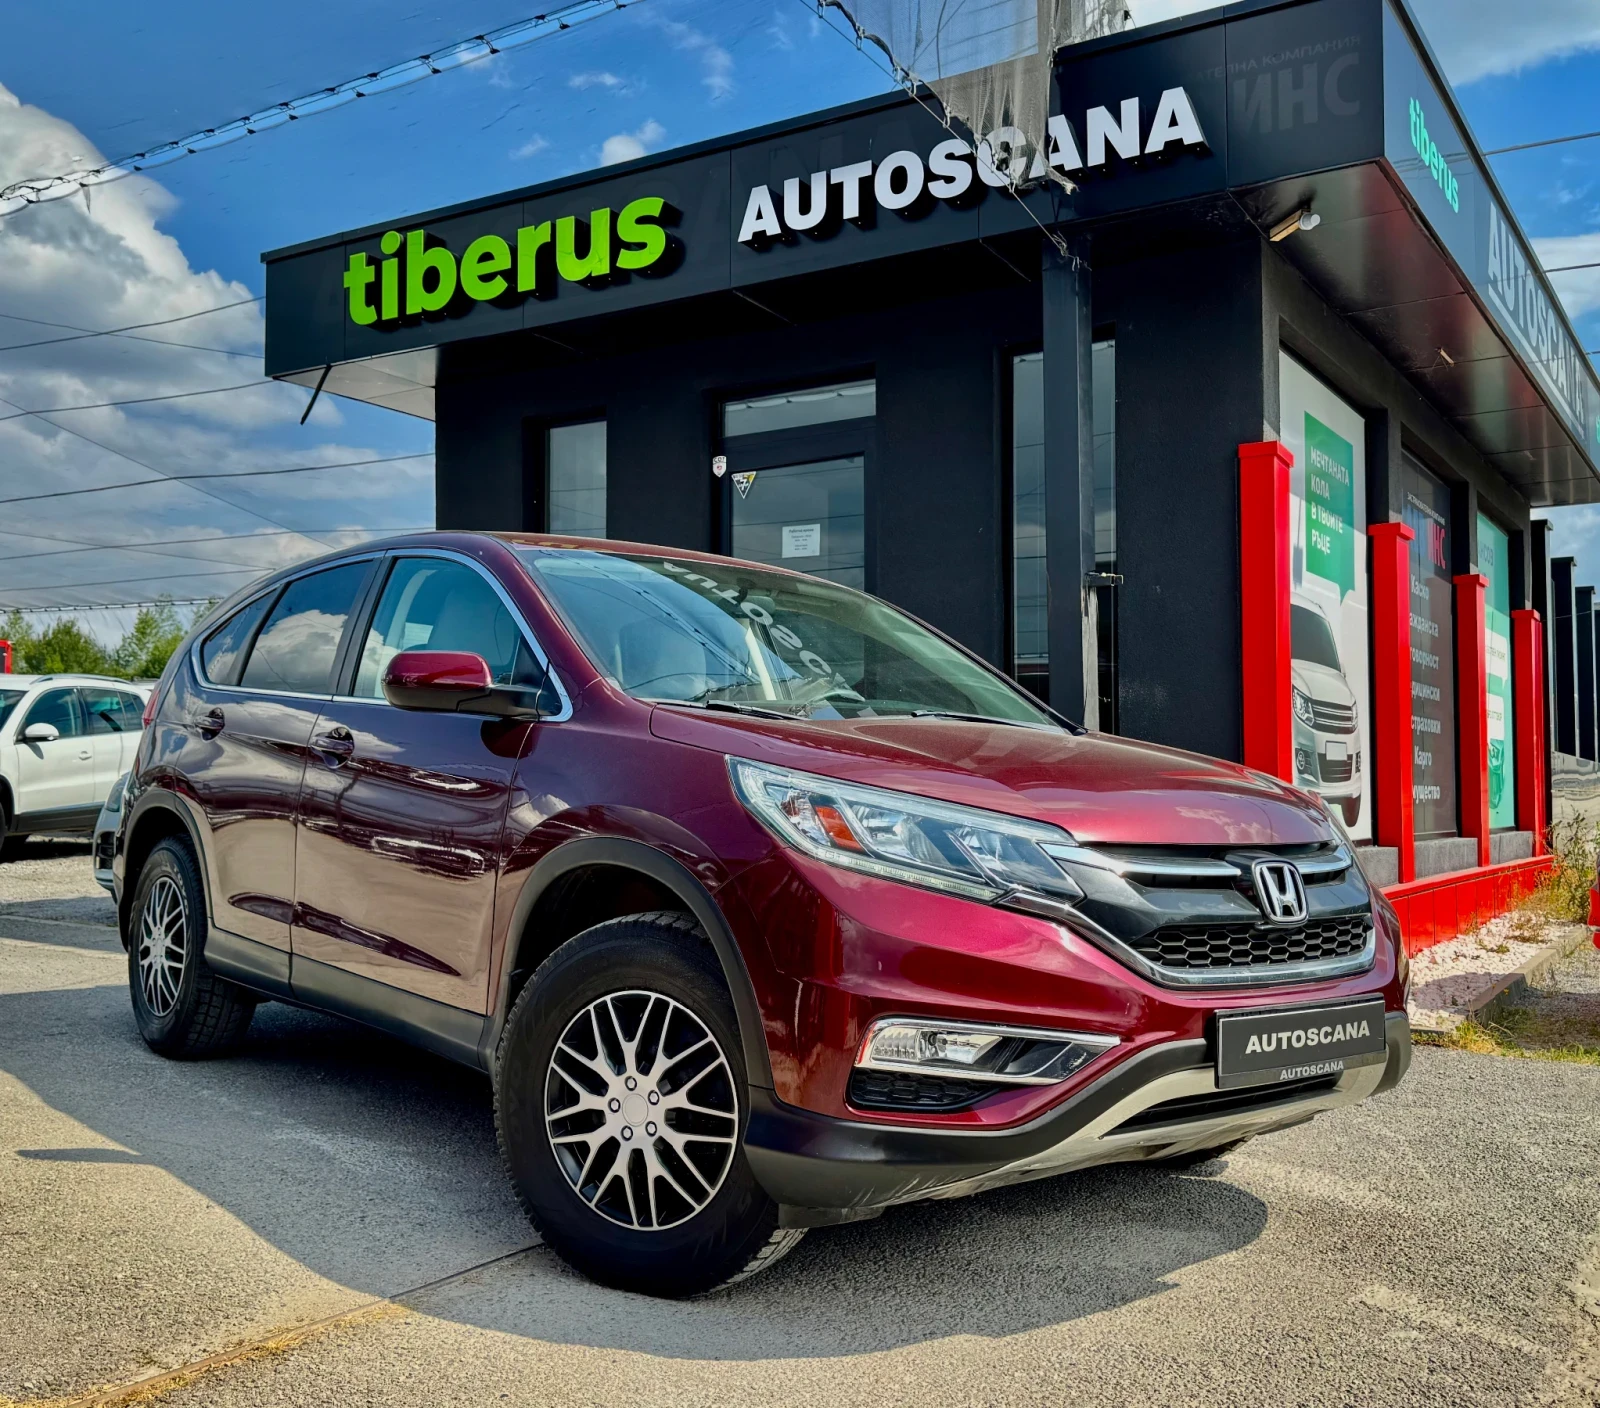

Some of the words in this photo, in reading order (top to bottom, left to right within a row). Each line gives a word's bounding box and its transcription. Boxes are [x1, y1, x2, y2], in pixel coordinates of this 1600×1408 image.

[738, 86, 1205, 243] AUTOSCANA
[1409, 97, 1459, 214] tiberus
[343, 196, 665, 326] tiberus
[1488, 201, 1584, 424] AUTOSCANA
[1310, 446, 1350, 487] МЕЧТАНАТА
[1311, 474, 1330, 500] КОЛА
[1311, 502, 1317, 519] В
[1318, 504, 1343, 534] ТВОИТЕ
[1311, 529, 1331, 555] РЪЦЕ
[1411, 574, 1430, 600] Каско
[1410, 612, 1439, 638] ажданска
[1410, 647, 1439, 670] говорност
[1411, 680, 1440, 702] дицински
[1410, 715, 1441, 735] страховки
[1414, 745, 1432, 769] Карго
[1412, 784, 1441, 804] ущество
[1245, 1020, 1370, 1054] AUTOSCANA
[1280, 1060, 1344, 1080] AUTOSCANA
